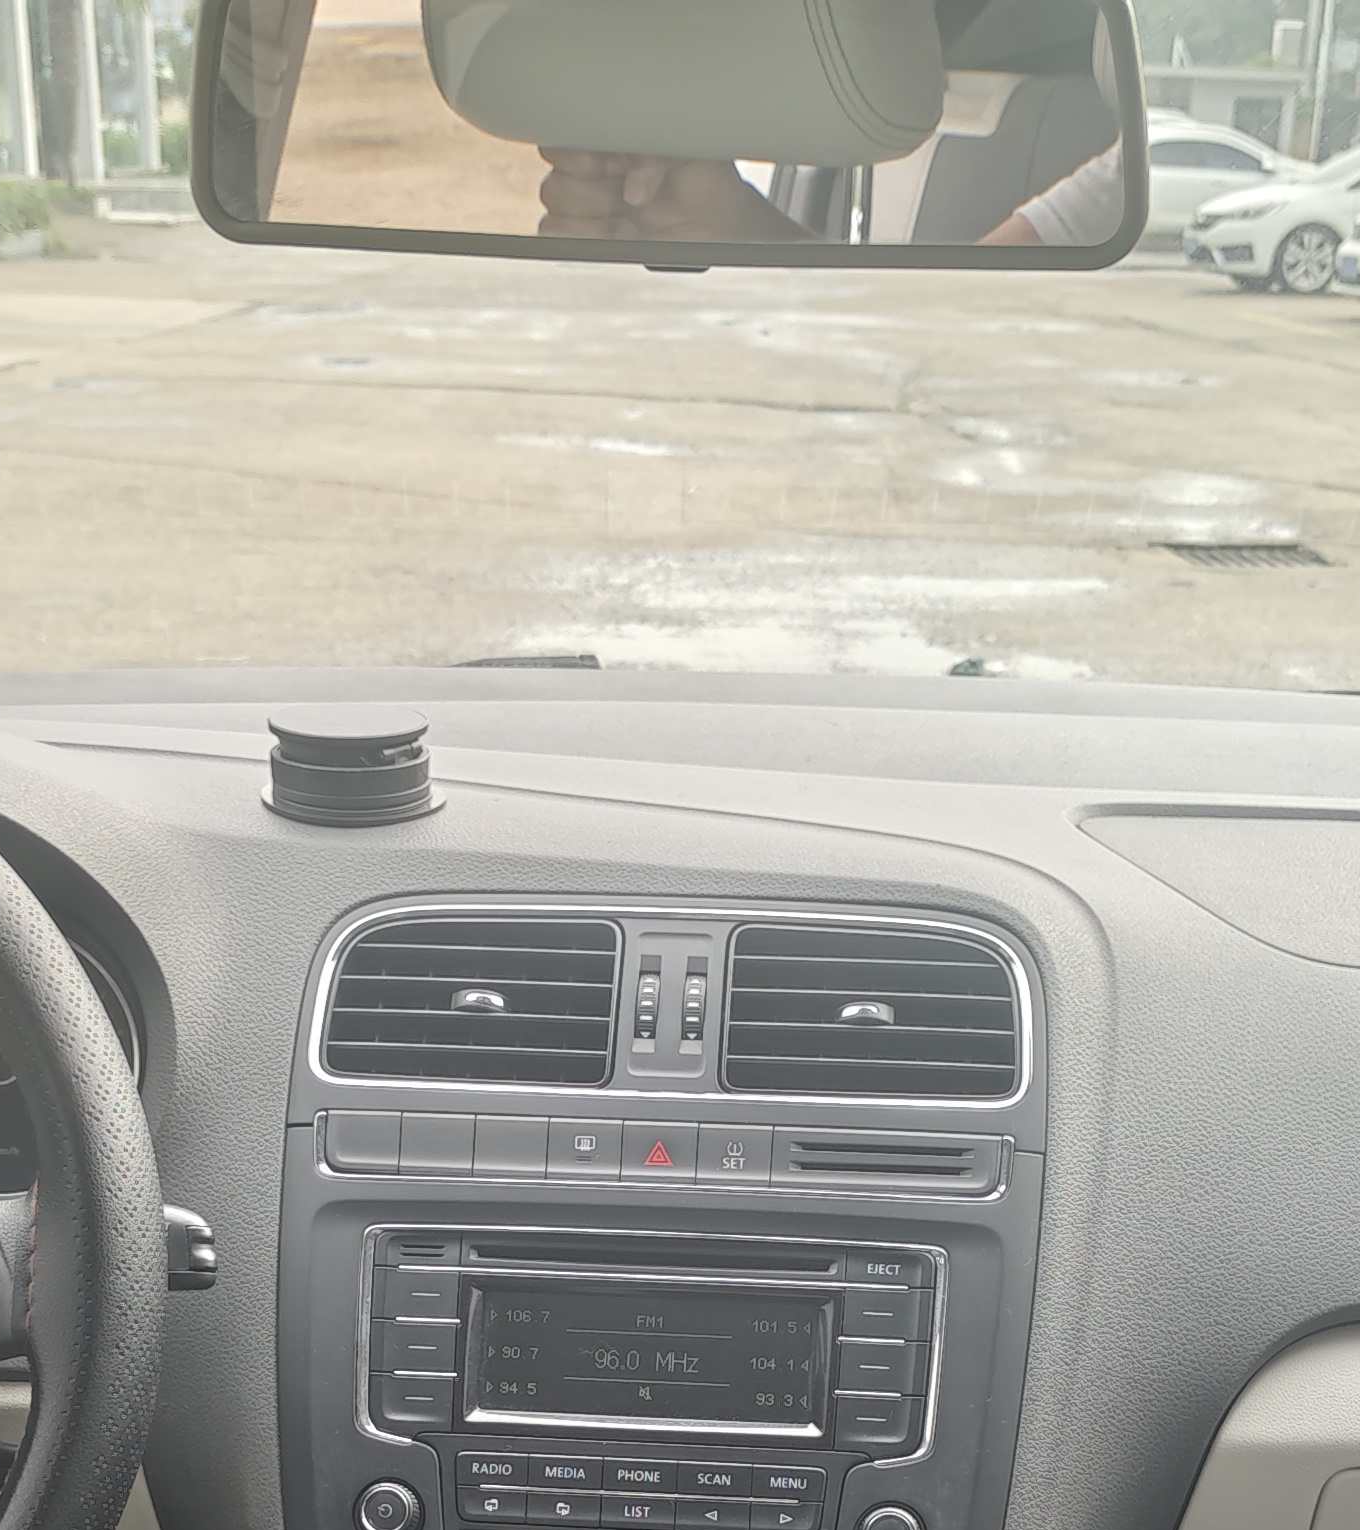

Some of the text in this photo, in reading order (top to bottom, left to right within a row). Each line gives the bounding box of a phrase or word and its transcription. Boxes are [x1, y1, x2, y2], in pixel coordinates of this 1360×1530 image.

[722, 1157, 746, 1170] SET
[867, 1263, 901, 1276] EJECT
[636, 1315, 665, 1329] FM1
[594, 1350, 699, 1374] 96.0 MHz
[472, 1462, 513, 1476] RADIO
[545, 1466, 586, 1480] MEDIA
[617, 1469, 661, 1483] PHONE
[697, 1473, 731, 1486] SCAN
[770, 1476, 807, 1490] MENU
[624, 1505, 651, 1519] LIST
